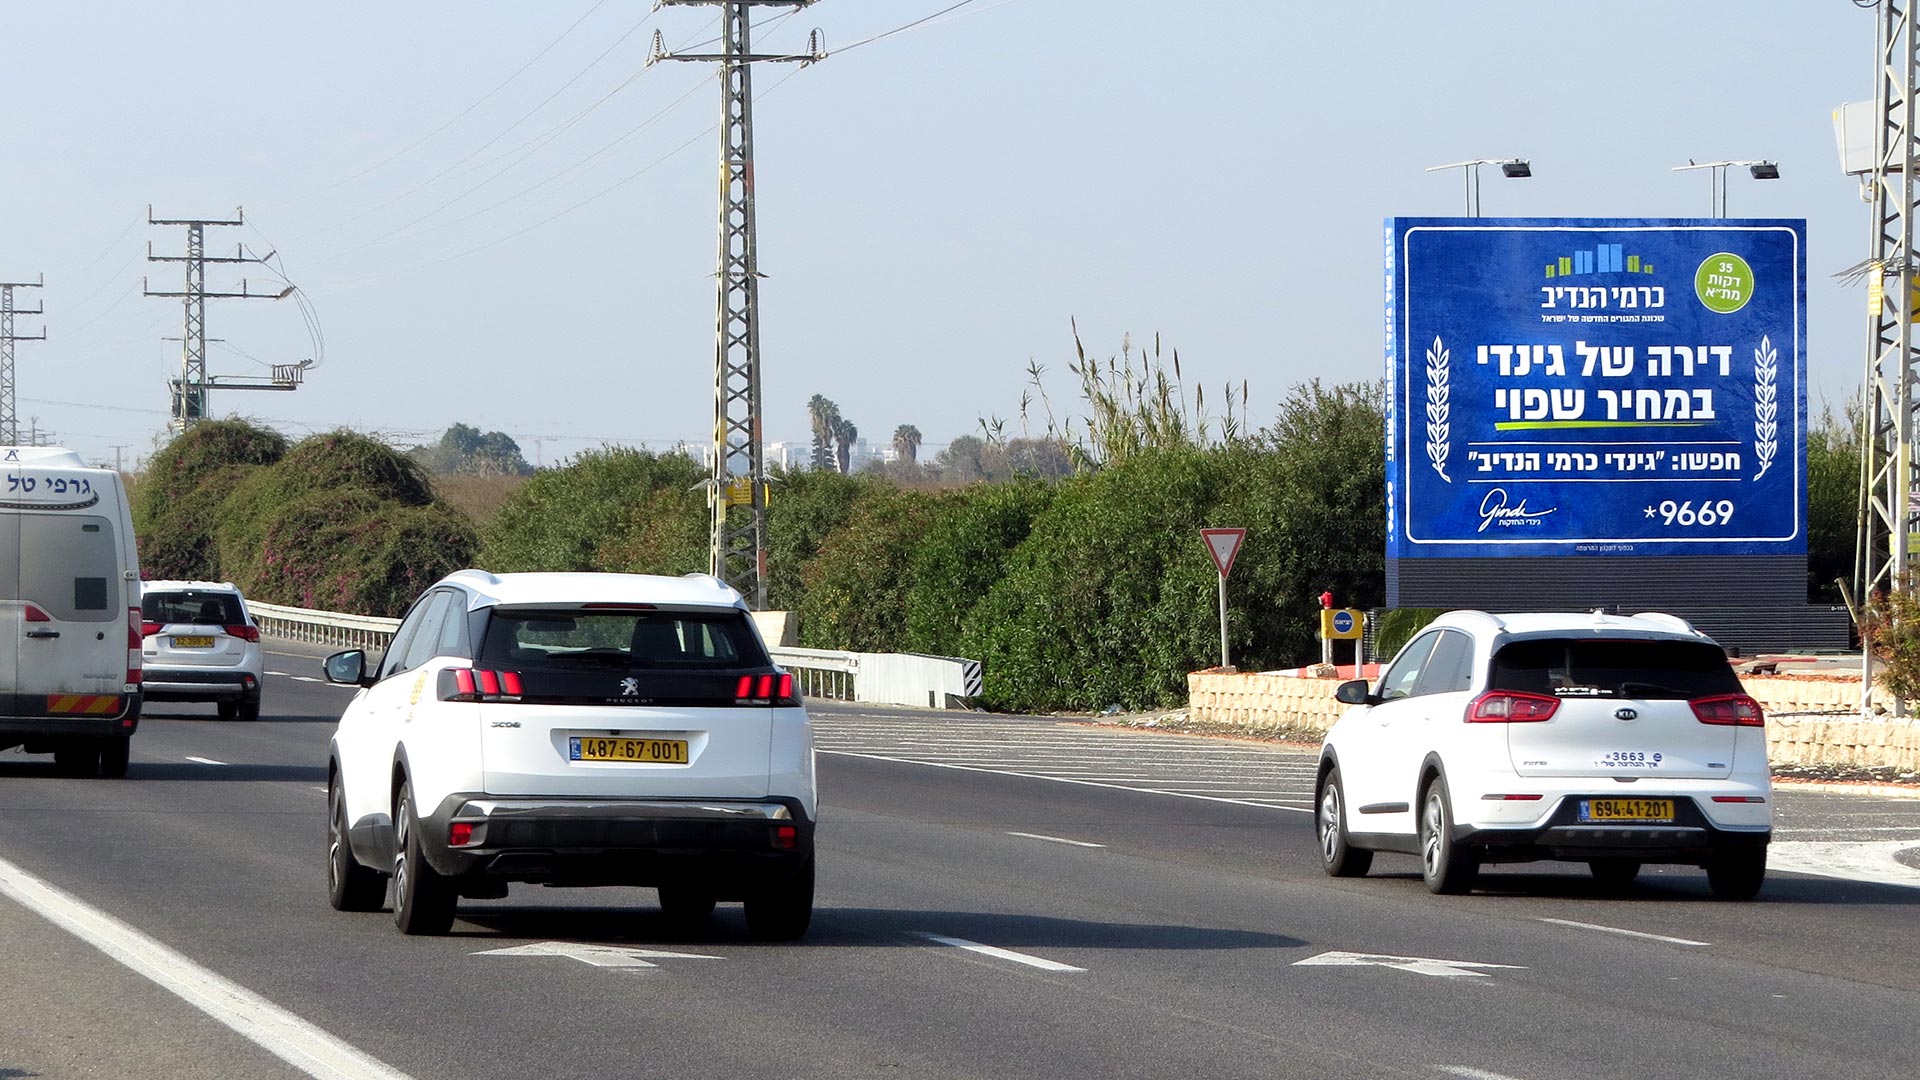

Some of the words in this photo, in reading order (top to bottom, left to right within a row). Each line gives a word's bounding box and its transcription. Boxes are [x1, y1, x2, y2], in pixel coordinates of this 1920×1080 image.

[1719, 262, 1733, 273] 35
[1707, 274, 1741, 288] דקות
[1541, 286, 1607, 308] הנדיב
[1611, 286, 1665, 308] כרמי
[1541, 314, 1566, 323] ישראל
[1567, 314, 1580, 323] של
[1580, 315, 1609, 323] החדשה
[1476, 345, 1566, 376] גינדי
[1576, 340, 1634, 377] של
[1648, 346, 1732, 376] דירה
[1495, 389, 1585, 420] שפוי
[1598, 389, 1715, 420] במחיר
[1547, 452, 1598, 471] כרמי
[1671, 452, 1741, 471] חפשו:
[7, 474, 36, 492] טל
[45, 477, 91, 494] גרפי
[1618, 710, 1635, 718] KIA
